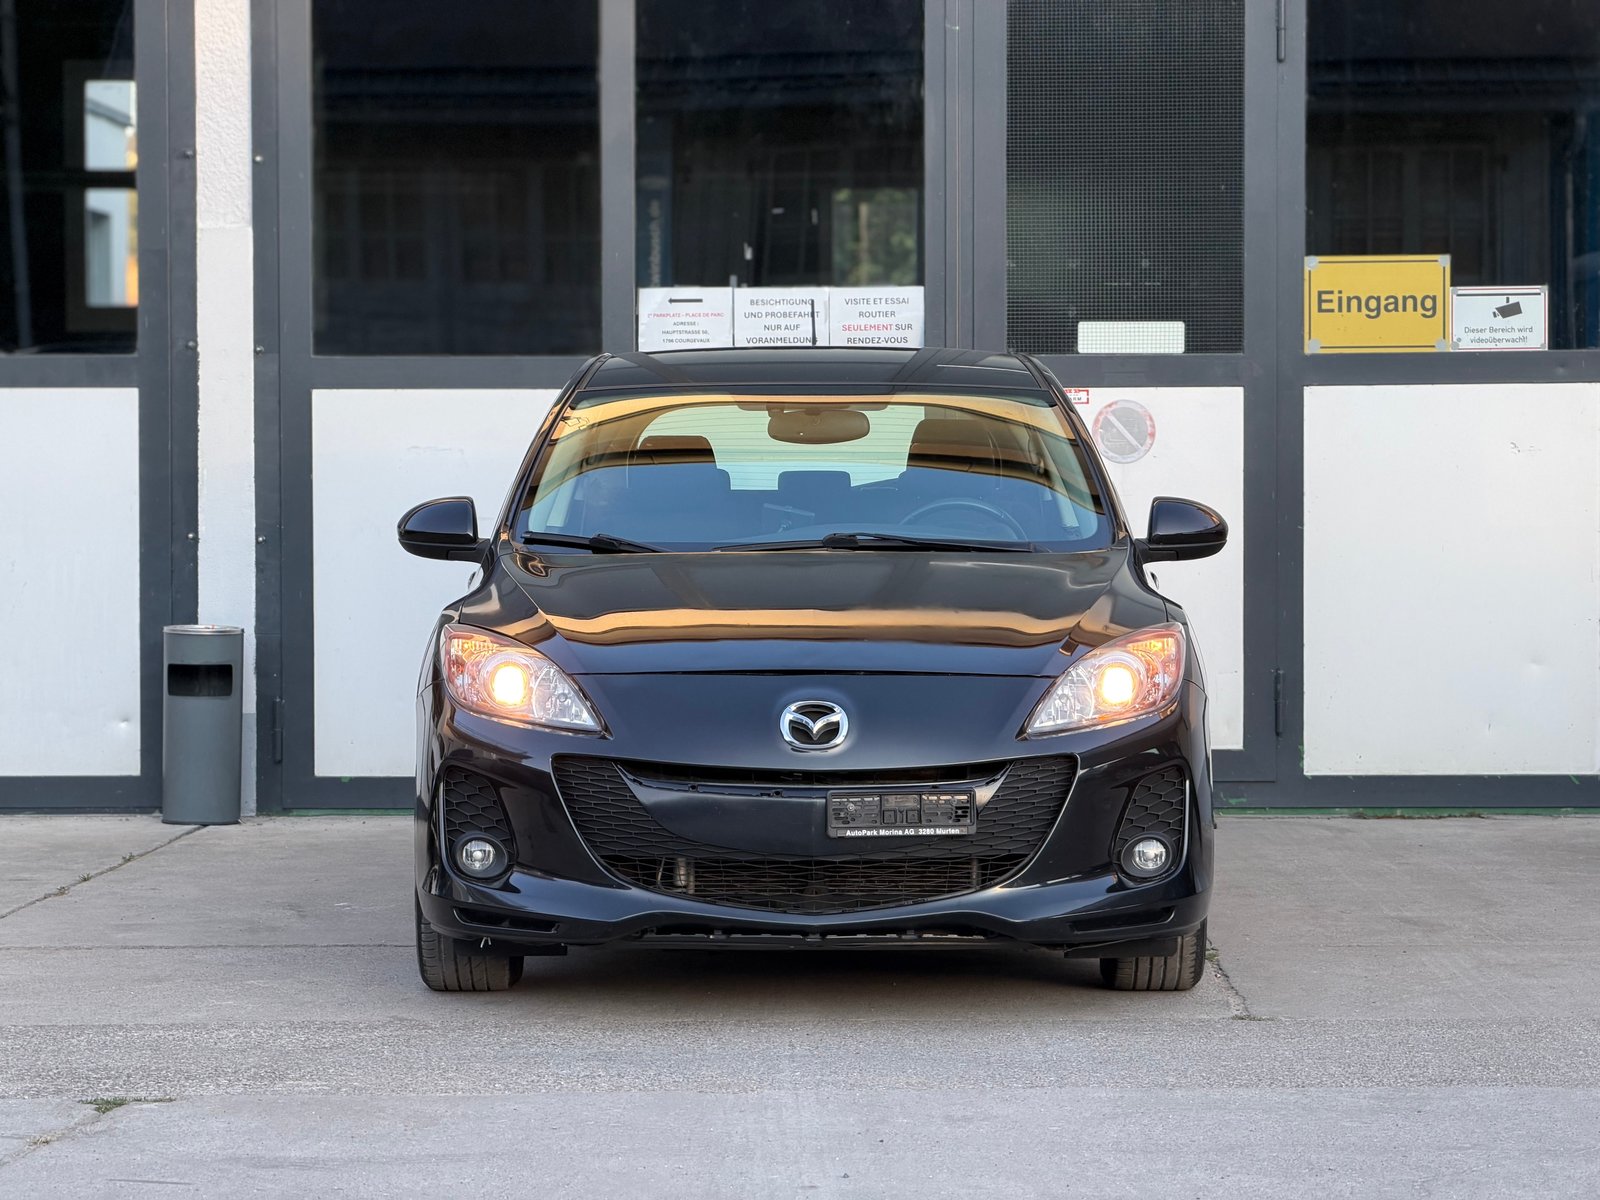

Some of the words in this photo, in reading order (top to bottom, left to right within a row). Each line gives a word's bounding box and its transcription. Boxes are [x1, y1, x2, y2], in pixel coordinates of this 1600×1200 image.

[844, 297, 871, 305] VISITE
[873, 297, 883, 305] ET
[885, 297, 910, 305] ESSAI
[1316, 290, 1438, 319] Eingang
[743, 311, 763, 319] UND
[858, 310, 896, 318] ROUTIER
[841, 323, 893, 332] SEULEMENT
[895, 323, 913, 331] SUR
[1464, 326, 1487, 334] Dieser
[1517, 325, 1533, 333] wird
[846, 336, 909, 344] RENDEZ-VOUS
[1470, 335, 1528, 344] videoüberwacht!
[936, 827, 960, 835] Murten
